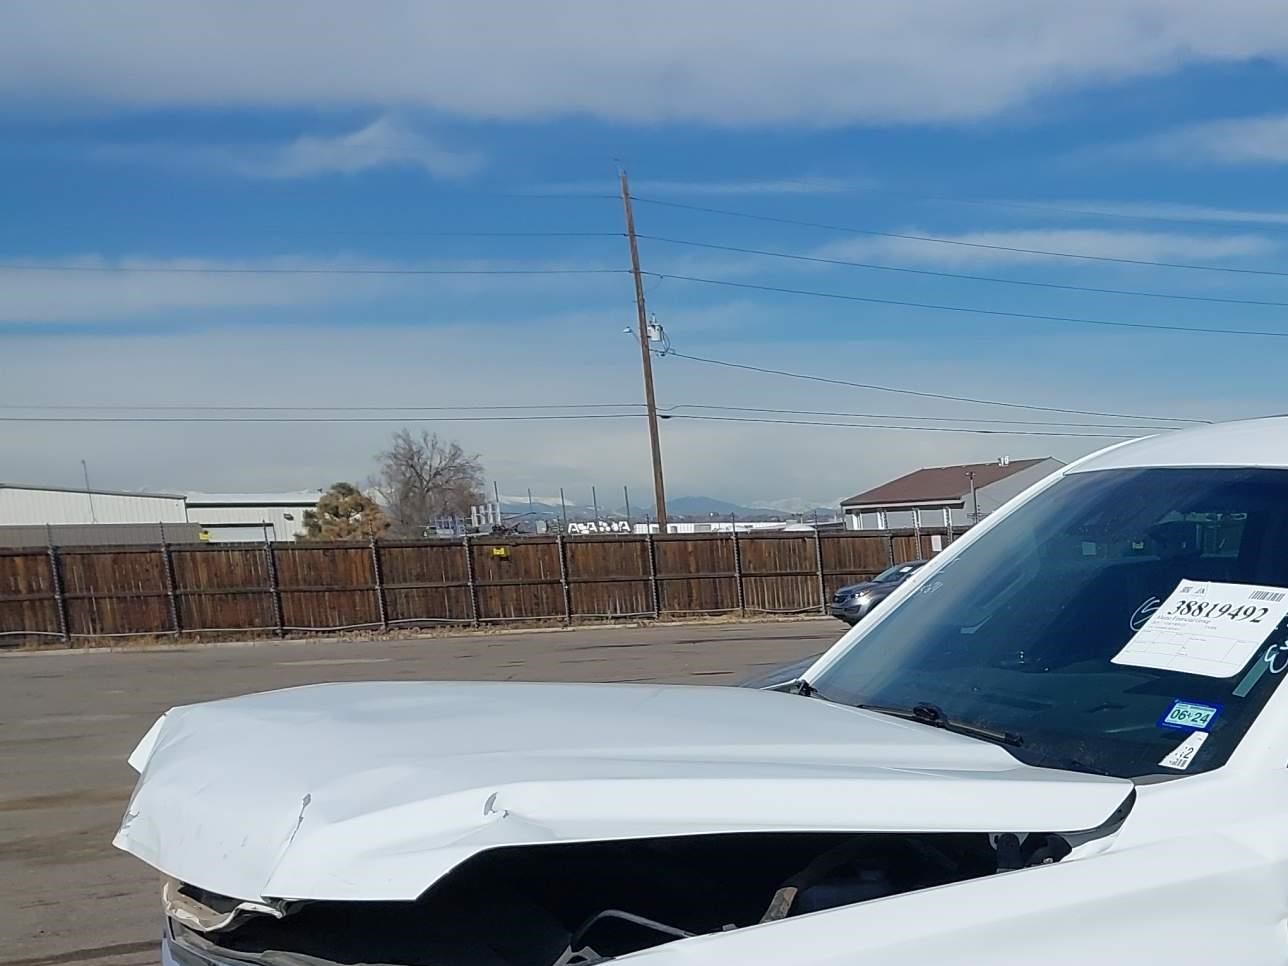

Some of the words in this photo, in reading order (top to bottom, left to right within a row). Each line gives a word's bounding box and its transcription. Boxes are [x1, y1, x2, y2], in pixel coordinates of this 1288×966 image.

[1168, 600, 1269, 624] 38819492
[1170, 708, 1188, 721] 06
[1191, 712, 1211, 724] 24
